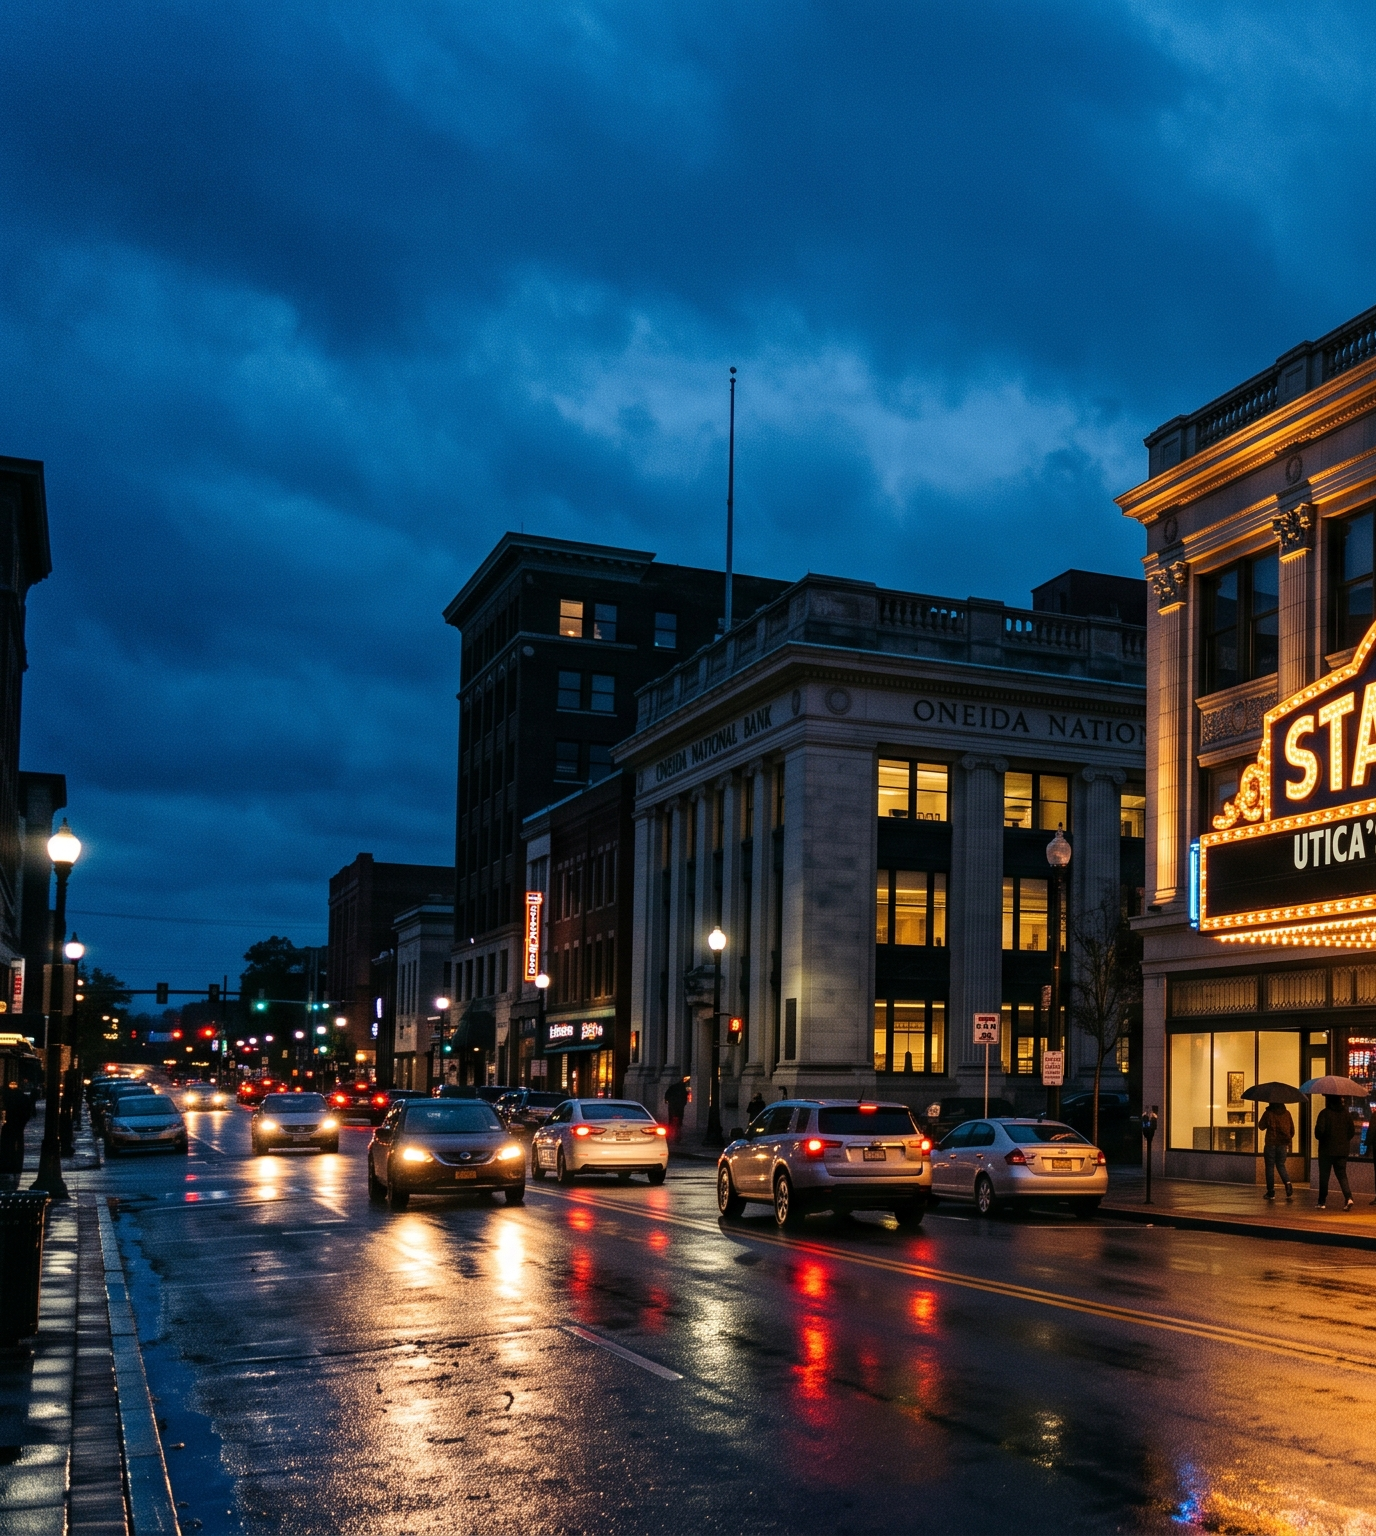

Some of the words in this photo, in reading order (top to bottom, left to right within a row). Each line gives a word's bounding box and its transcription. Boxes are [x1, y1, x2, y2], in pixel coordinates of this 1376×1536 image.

[656, 750, 688, 782] ONEIDA
[692, 723, 738, 765] NATIONAL
[744, 705, 772, 739] BANK
[913, 699, 1030, 733] ONEIDA
